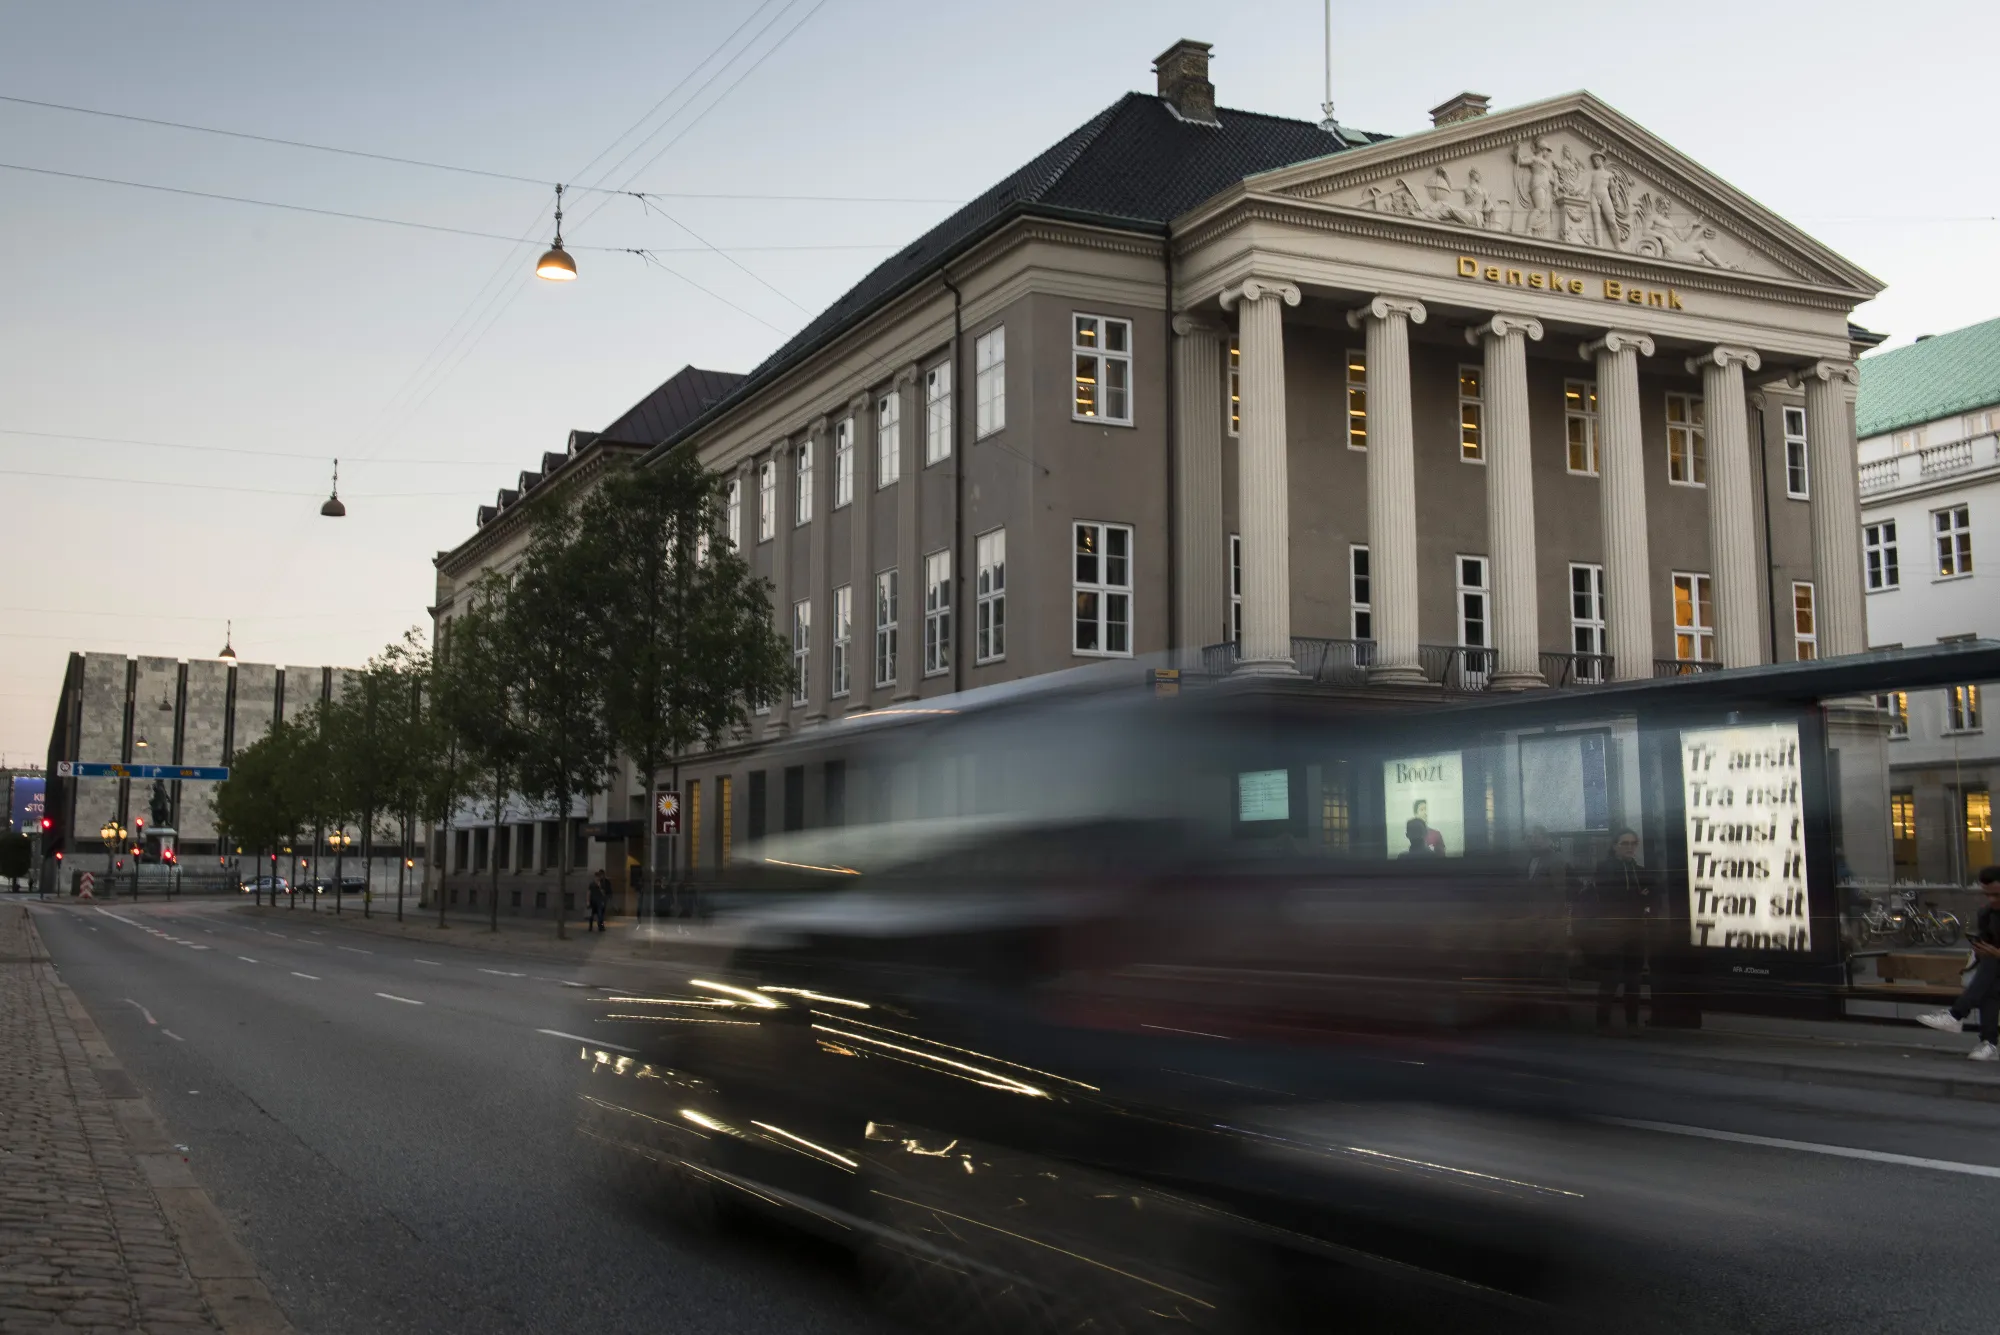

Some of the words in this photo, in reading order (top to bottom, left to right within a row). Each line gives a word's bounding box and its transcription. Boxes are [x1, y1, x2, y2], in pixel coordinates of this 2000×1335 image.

[1458, 256, 1585, 294] Danske
[1603, 278, 1683, 310] Bank
[1396, 762, 1443, 784] Boozt
